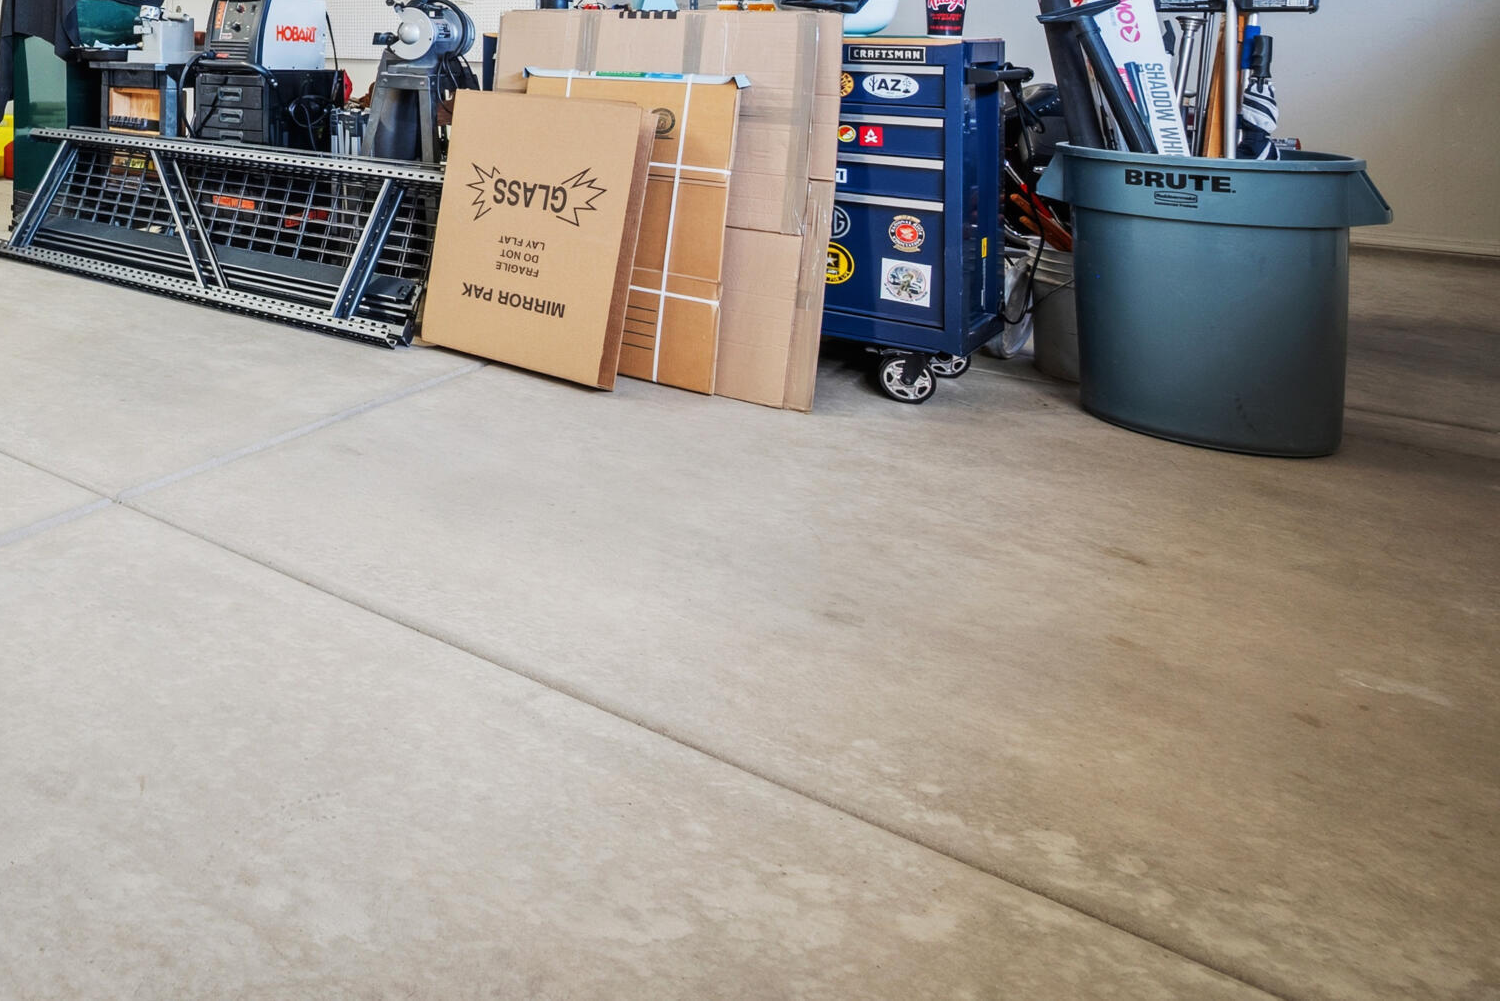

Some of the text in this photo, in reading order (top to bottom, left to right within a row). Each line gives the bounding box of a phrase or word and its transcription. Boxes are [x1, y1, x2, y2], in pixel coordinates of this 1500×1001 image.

[276, 24, 317, 43] HOBART
[853, 49, 920, 59] CRAFTSMAN
[877, 78, 901, 92] AZ
[1145, 62, 1184, 157] SHADOW WHI
[492, 177, 567, 213] GLASS
[498, 235, 546, 251] LAY FLAT
[499, 249, 539, 264] DO NOT
[495, 261, 539, 278] FRAGILE
[461, 282, 566, 318] MIRROR PAK
